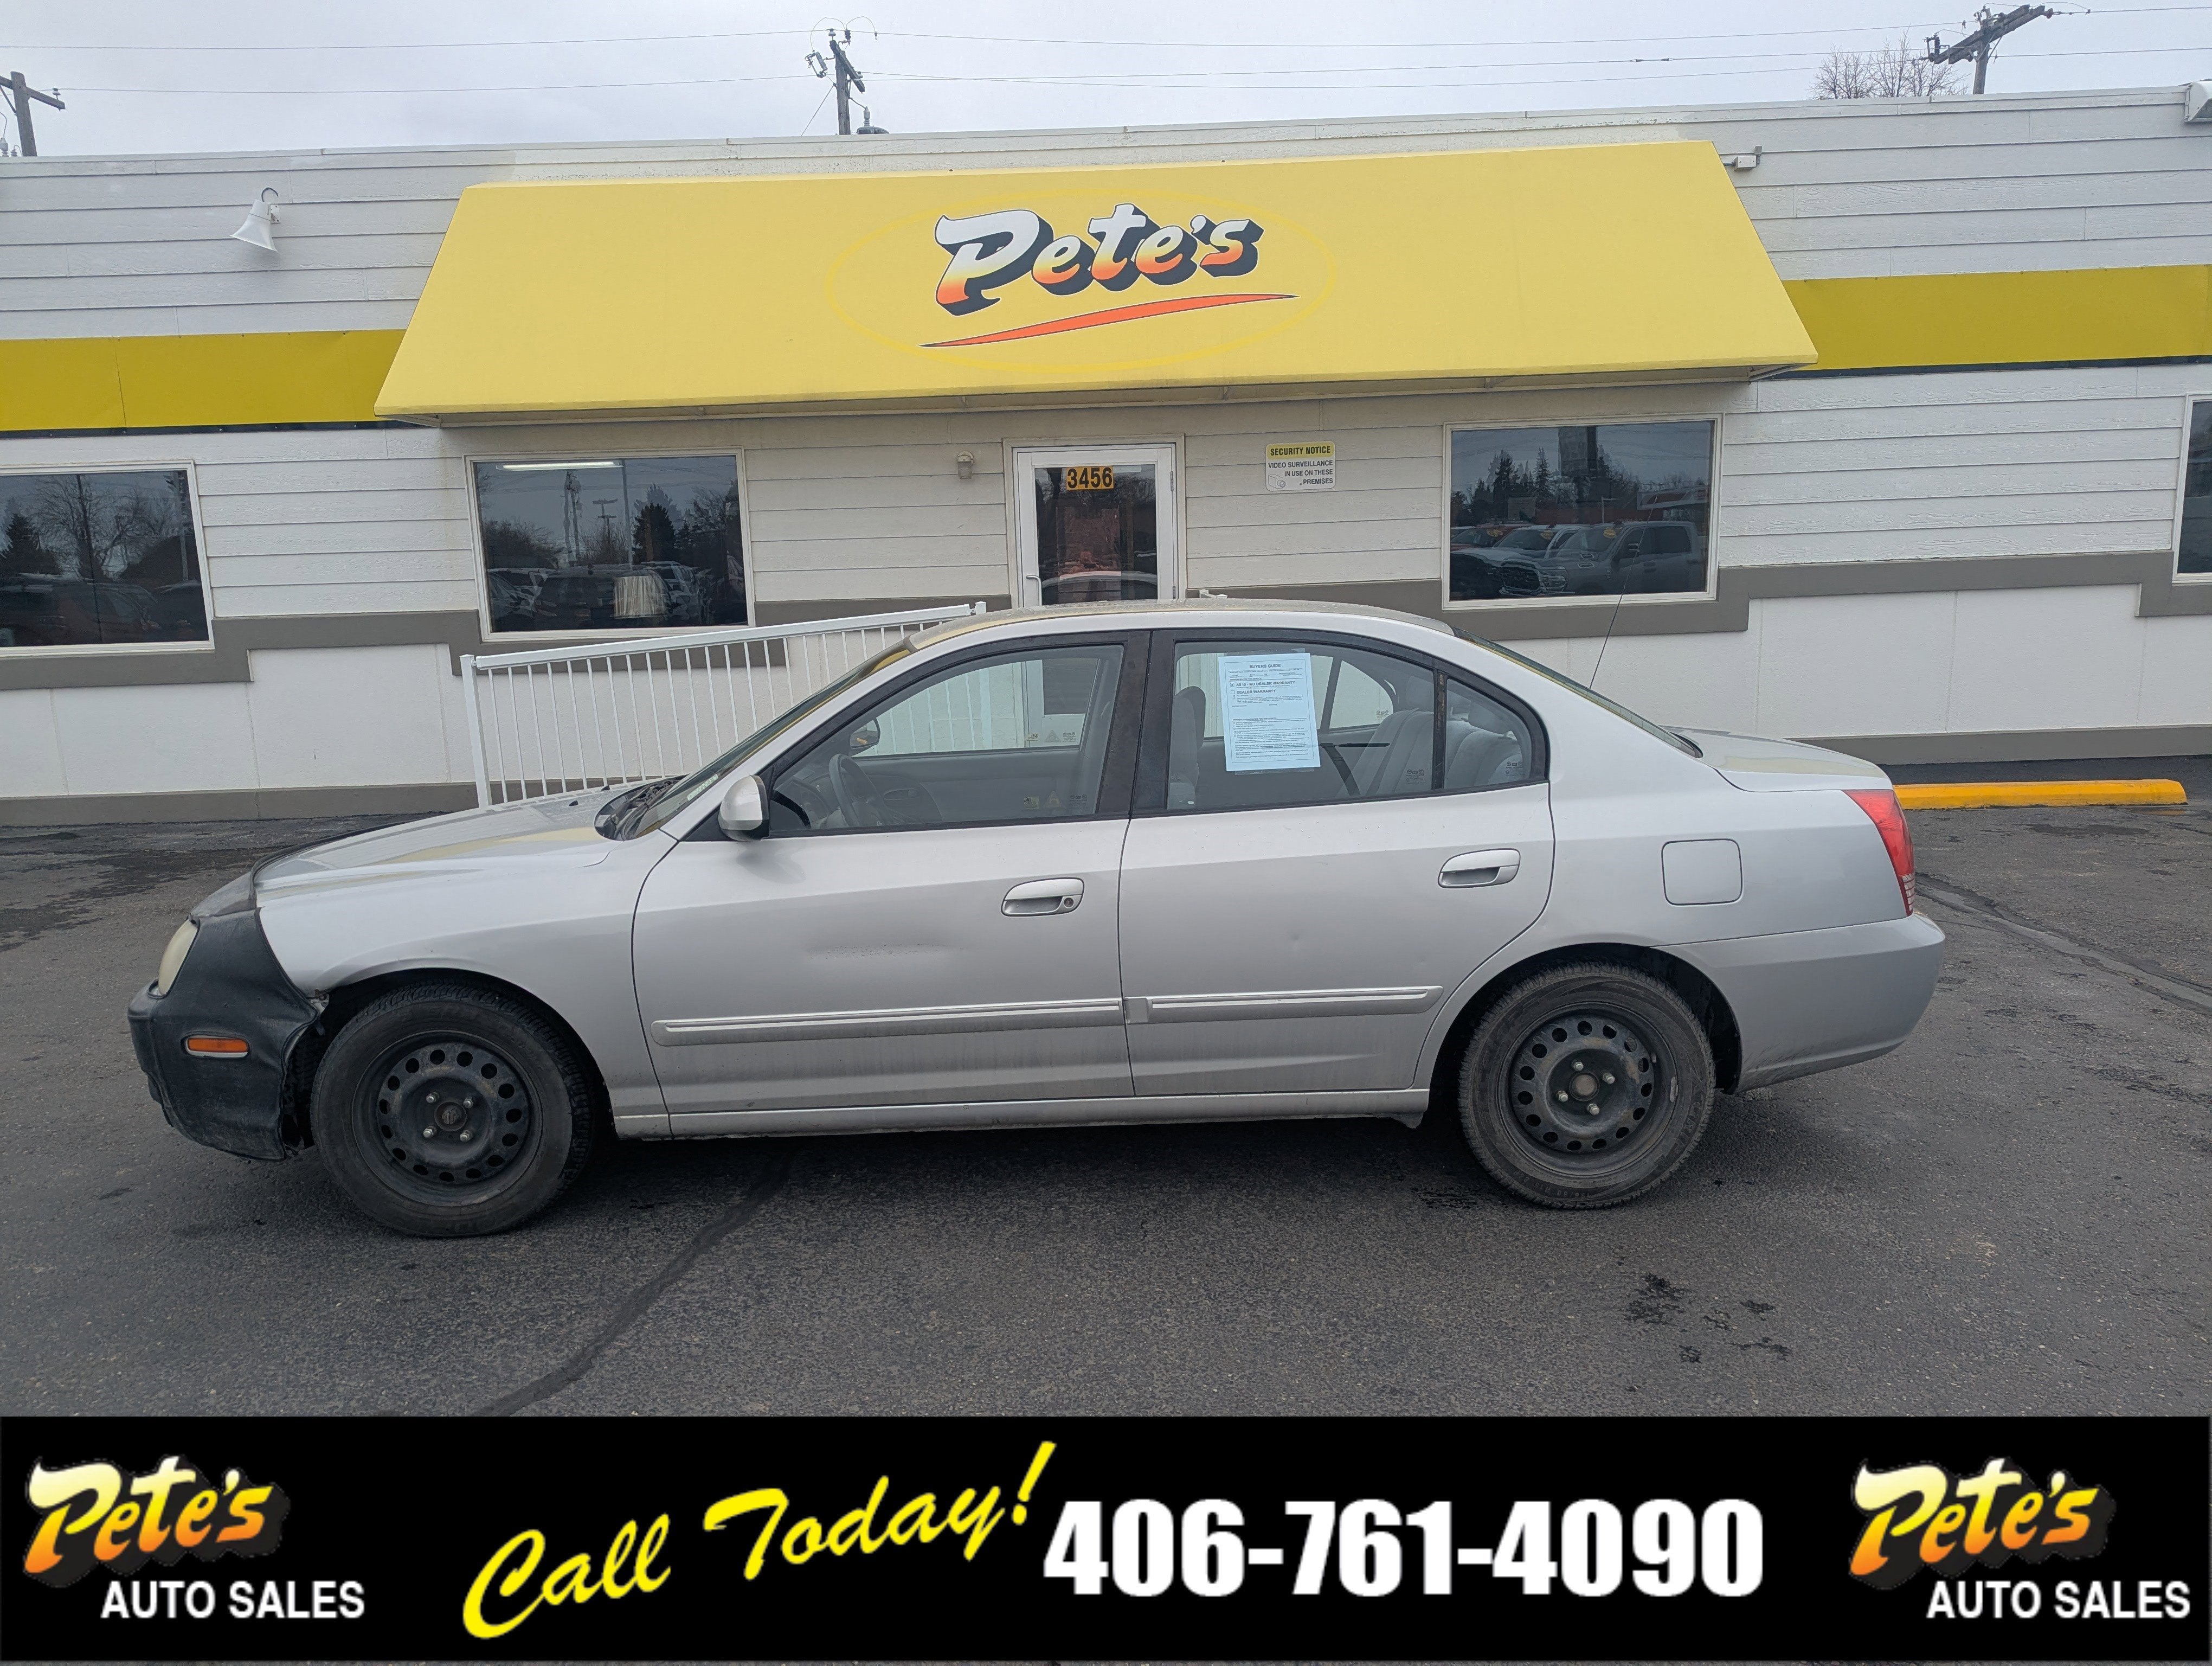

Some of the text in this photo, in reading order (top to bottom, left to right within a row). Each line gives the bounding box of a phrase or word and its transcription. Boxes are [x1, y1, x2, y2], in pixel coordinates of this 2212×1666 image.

[934, 202, 1264, 316] Pete's
[1270, 446, 1331, 456] SECURITY NOTICE
[1067, 466, 1113, 488] 3456
